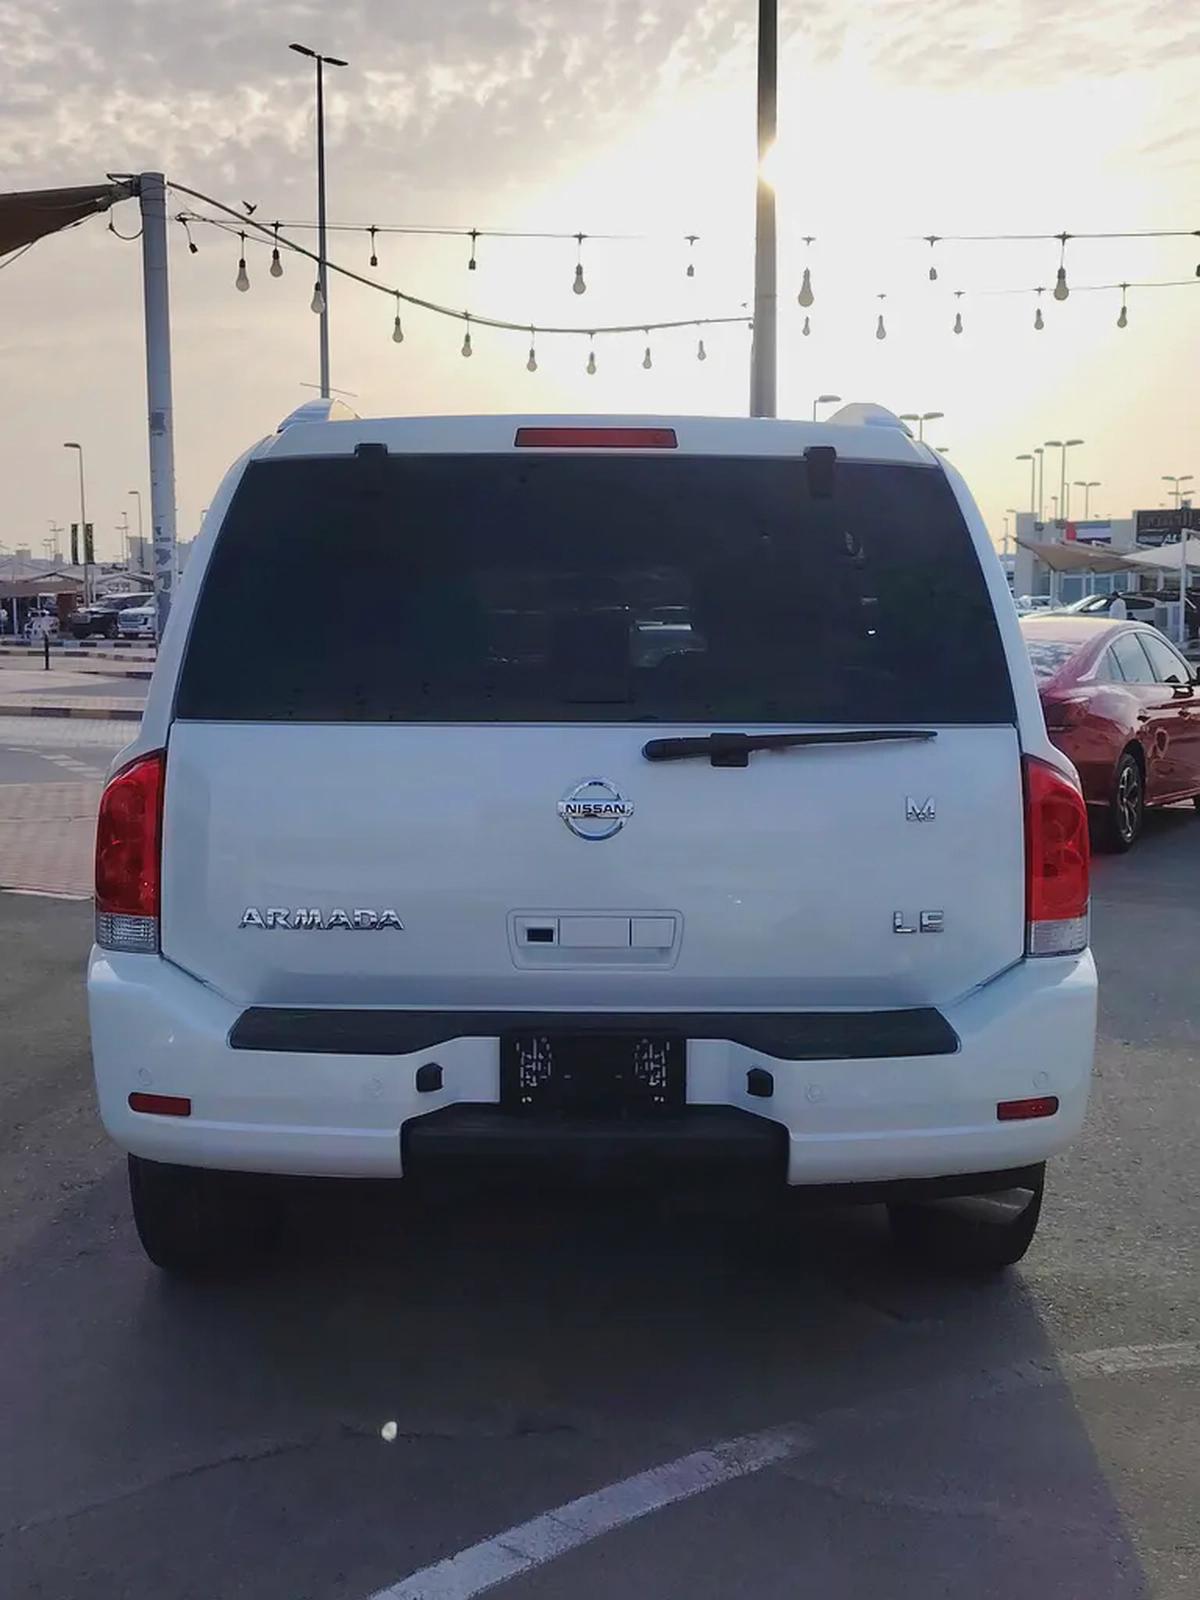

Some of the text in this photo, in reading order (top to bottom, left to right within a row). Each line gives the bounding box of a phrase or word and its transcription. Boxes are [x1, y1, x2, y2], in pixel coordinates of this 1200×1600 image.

[565, 803, 625, 814] NISSAN
[239, 906, 404, 930] ARMADA
[893, 910, 944, 933] LE
